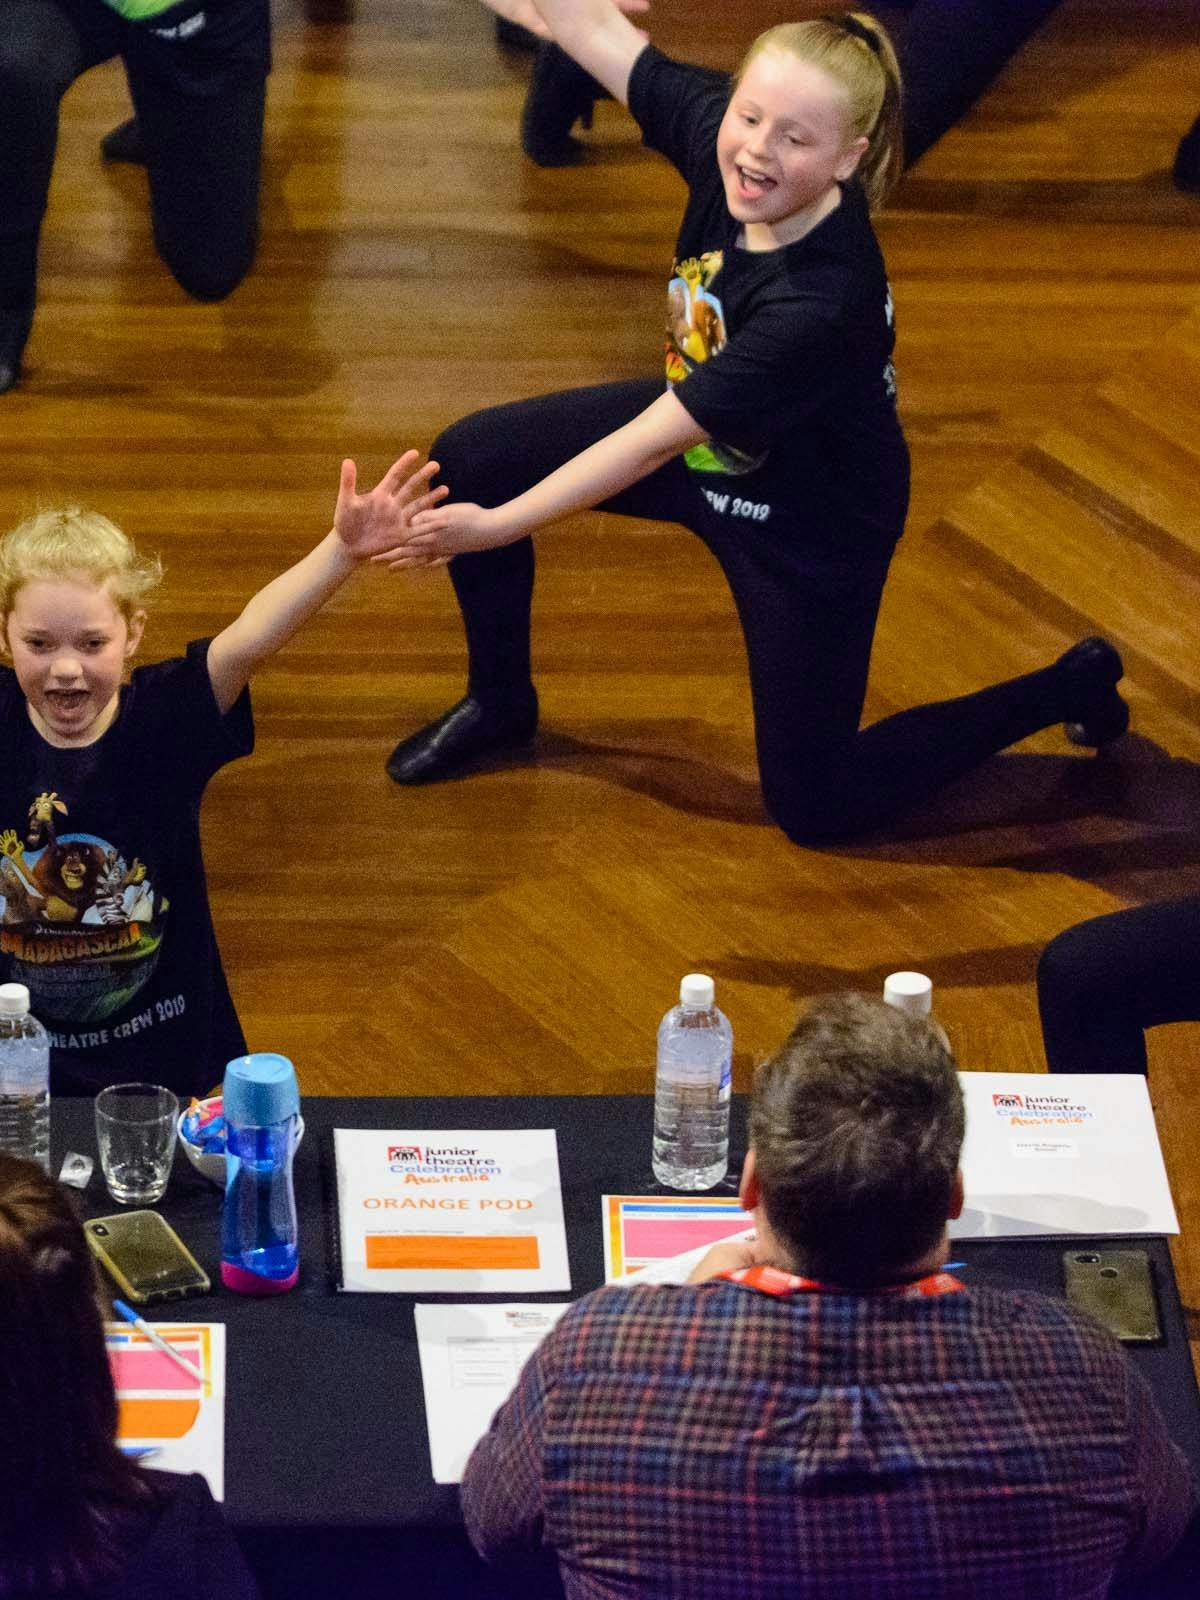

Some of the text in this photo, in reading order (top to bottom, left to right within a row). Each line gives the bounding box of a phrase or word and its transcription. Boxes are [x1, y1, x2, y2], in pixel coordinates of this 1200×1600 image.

[730, 497, 771, 521] 2019
[48, 994, 187, 1049] HEATRE CREW 2019
[1025, 1095, 1071, 1104] junior
[1025, 1103, 1087, 1111] theatre
[425, 1146, 479, 1157] junior
[425, 1157, 496, 1166] theatre
[389, 1164, 502, 1175] Celebration
[403, 1173, 491, 1185] Australia
[363, 1197, 534, 1211] ORANGE POD
